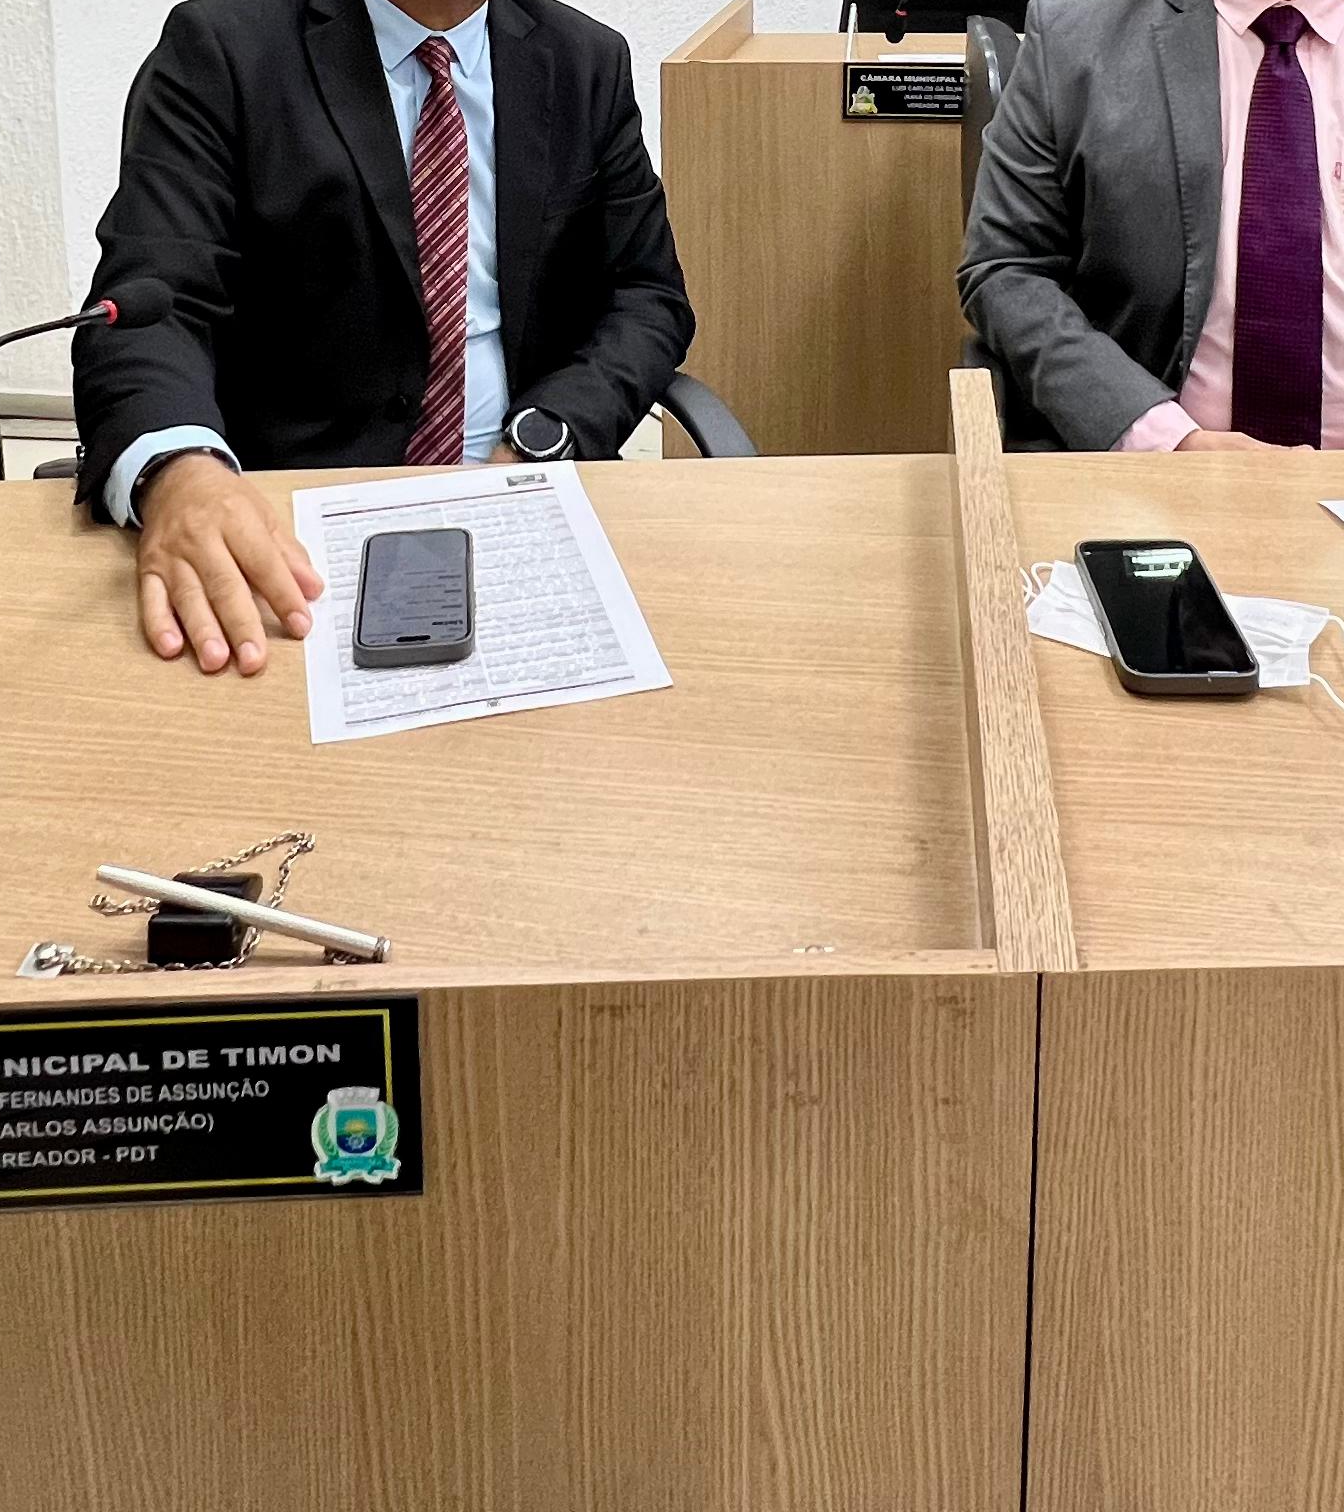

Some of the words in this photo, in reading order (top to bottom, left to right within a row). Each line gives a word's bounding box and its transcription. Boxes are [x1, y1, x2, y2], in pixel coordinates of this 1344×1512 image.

[161, 1048, 211, 1072] DE
[219, 1042, 342, 1068] TIMON
[125, 1085, 154, 1105] DE
[157, 1077, 271, 1103] ASSUNÇÃO
[81, 1110, 216, 1137] ASSUNÇÃO)
[115, 1144, 160, 1164] PDT
